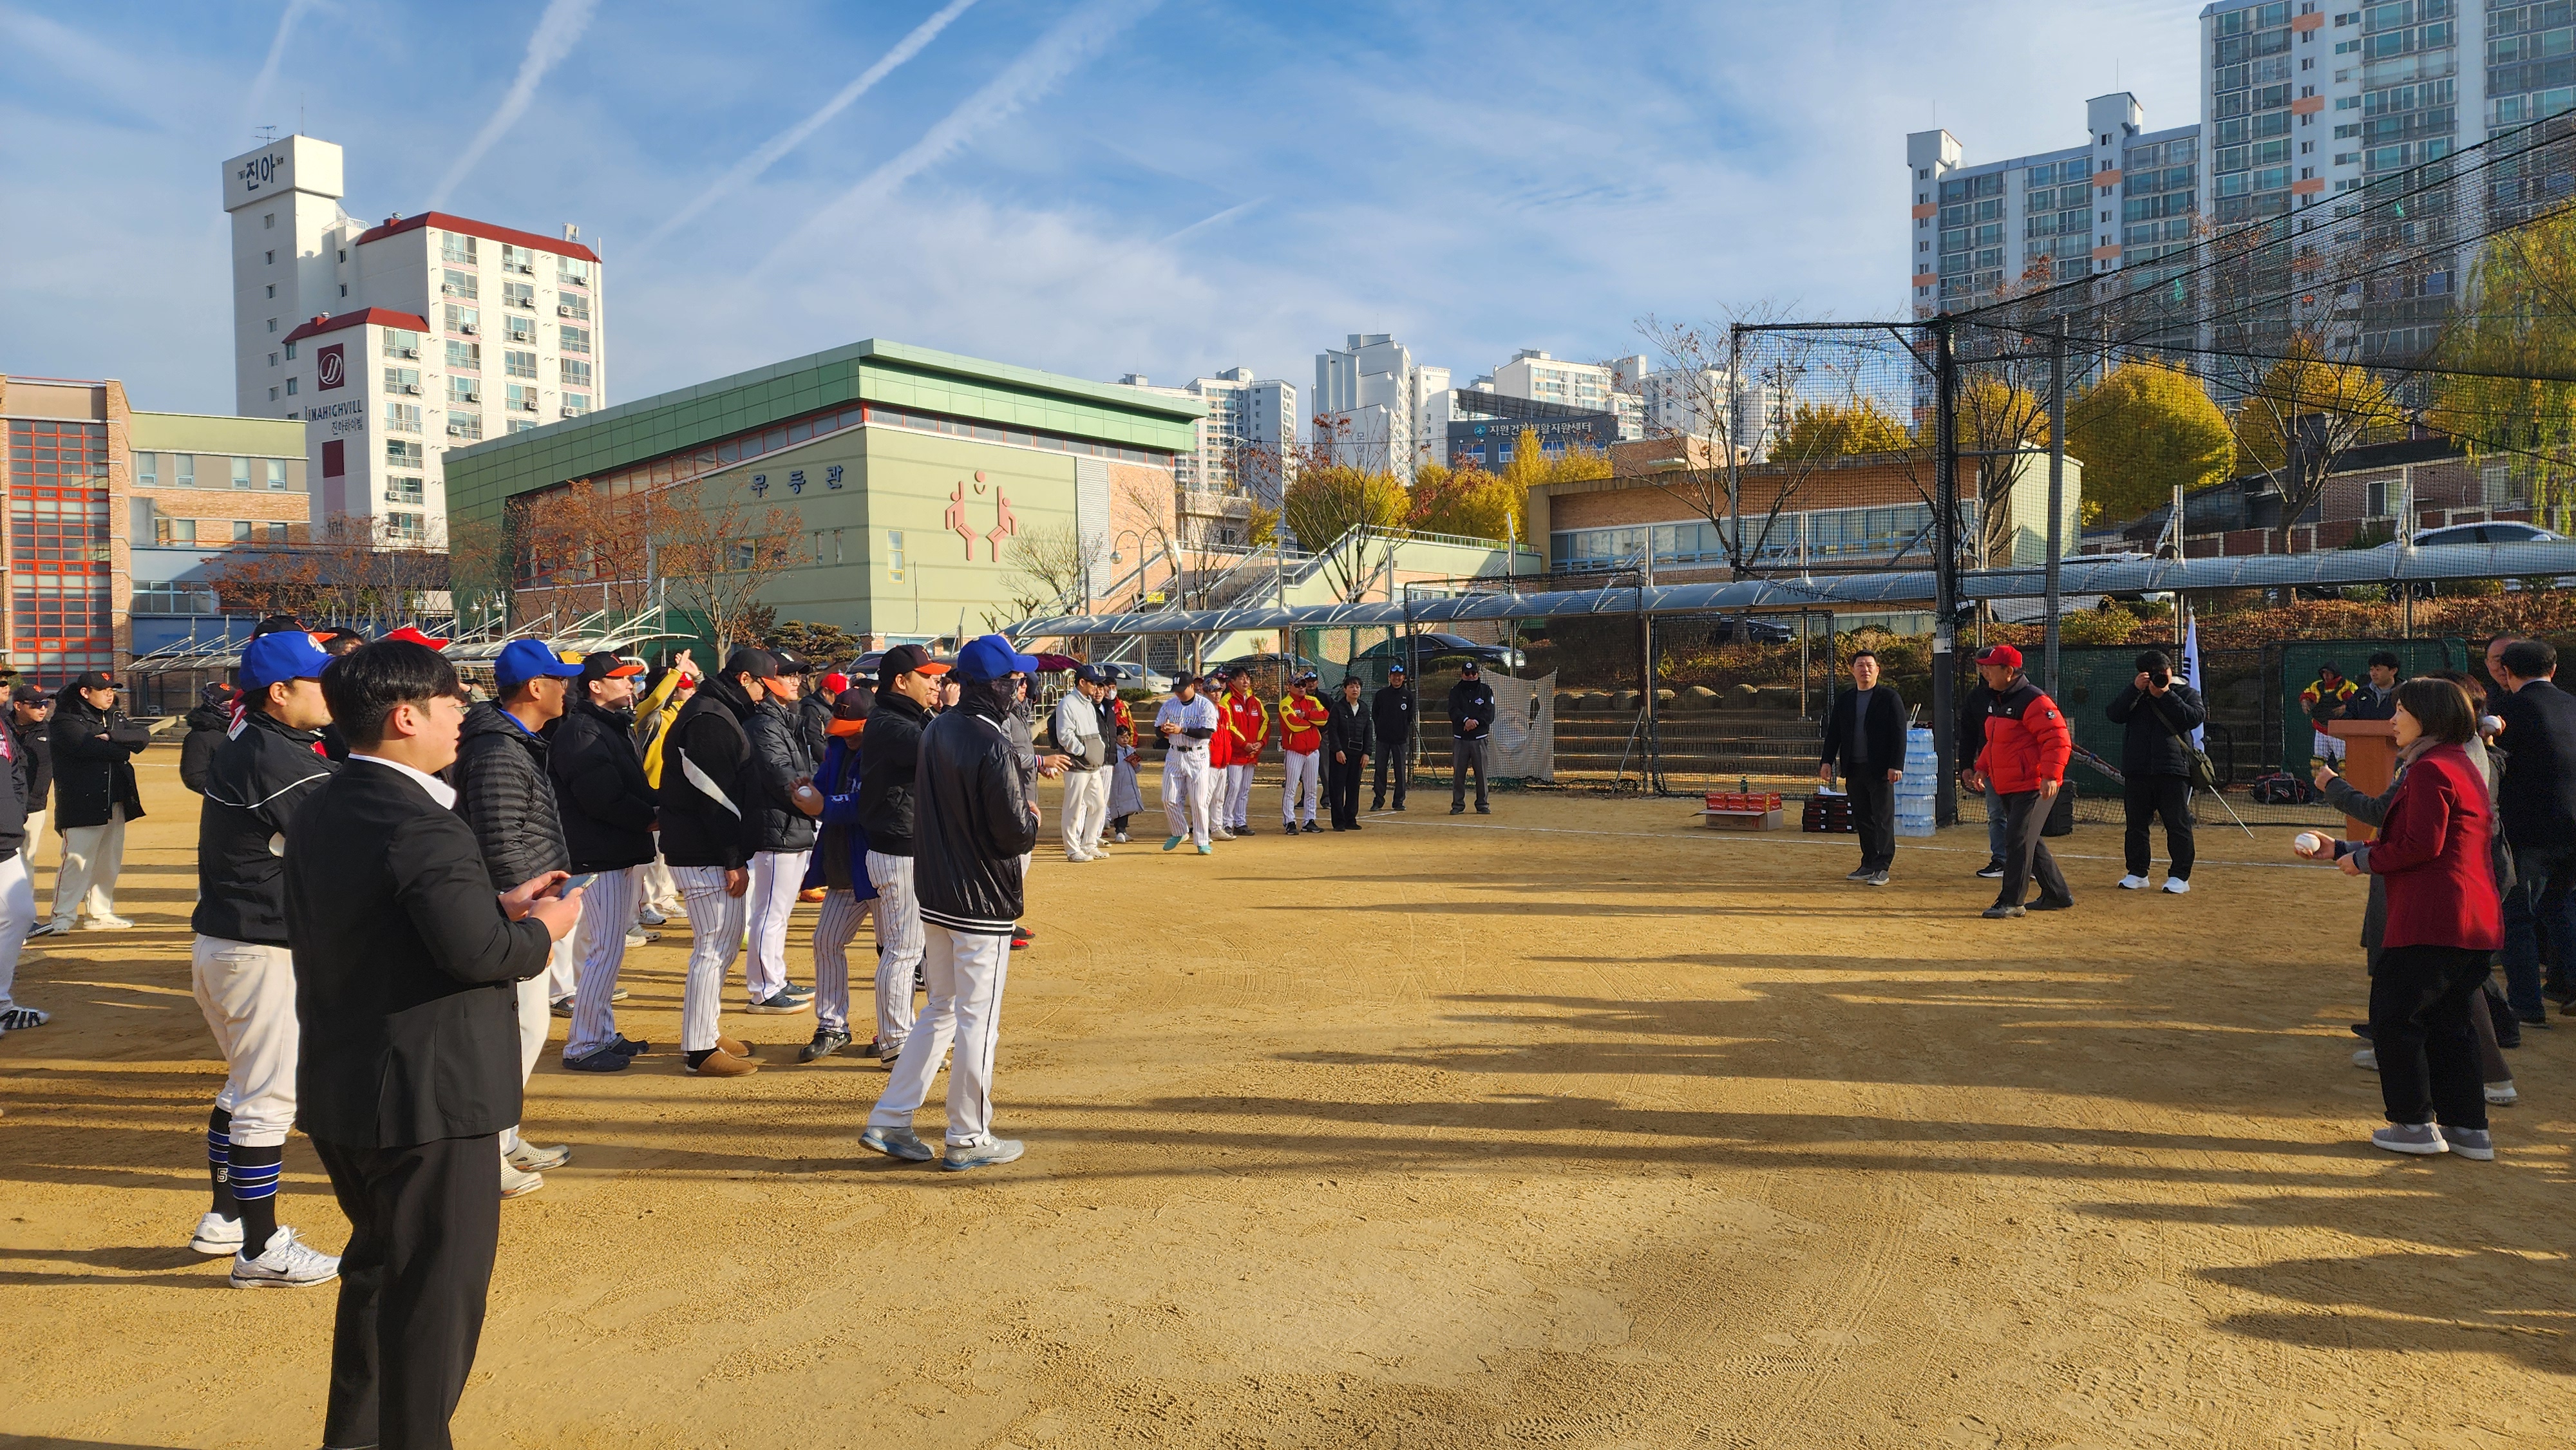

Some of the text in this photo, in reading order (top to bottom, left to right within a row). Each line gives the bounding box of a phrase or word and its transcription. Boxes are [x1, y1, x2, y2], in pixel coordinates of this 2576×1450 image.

[246, 153, 276, 191] 진아
[331, 416, 363, 435] 진아하이빌
[750, 465, 844, 498] 무등관
[0, 1010, 41, 1030] AIR
[216, 1167, 229, 1183] 5
